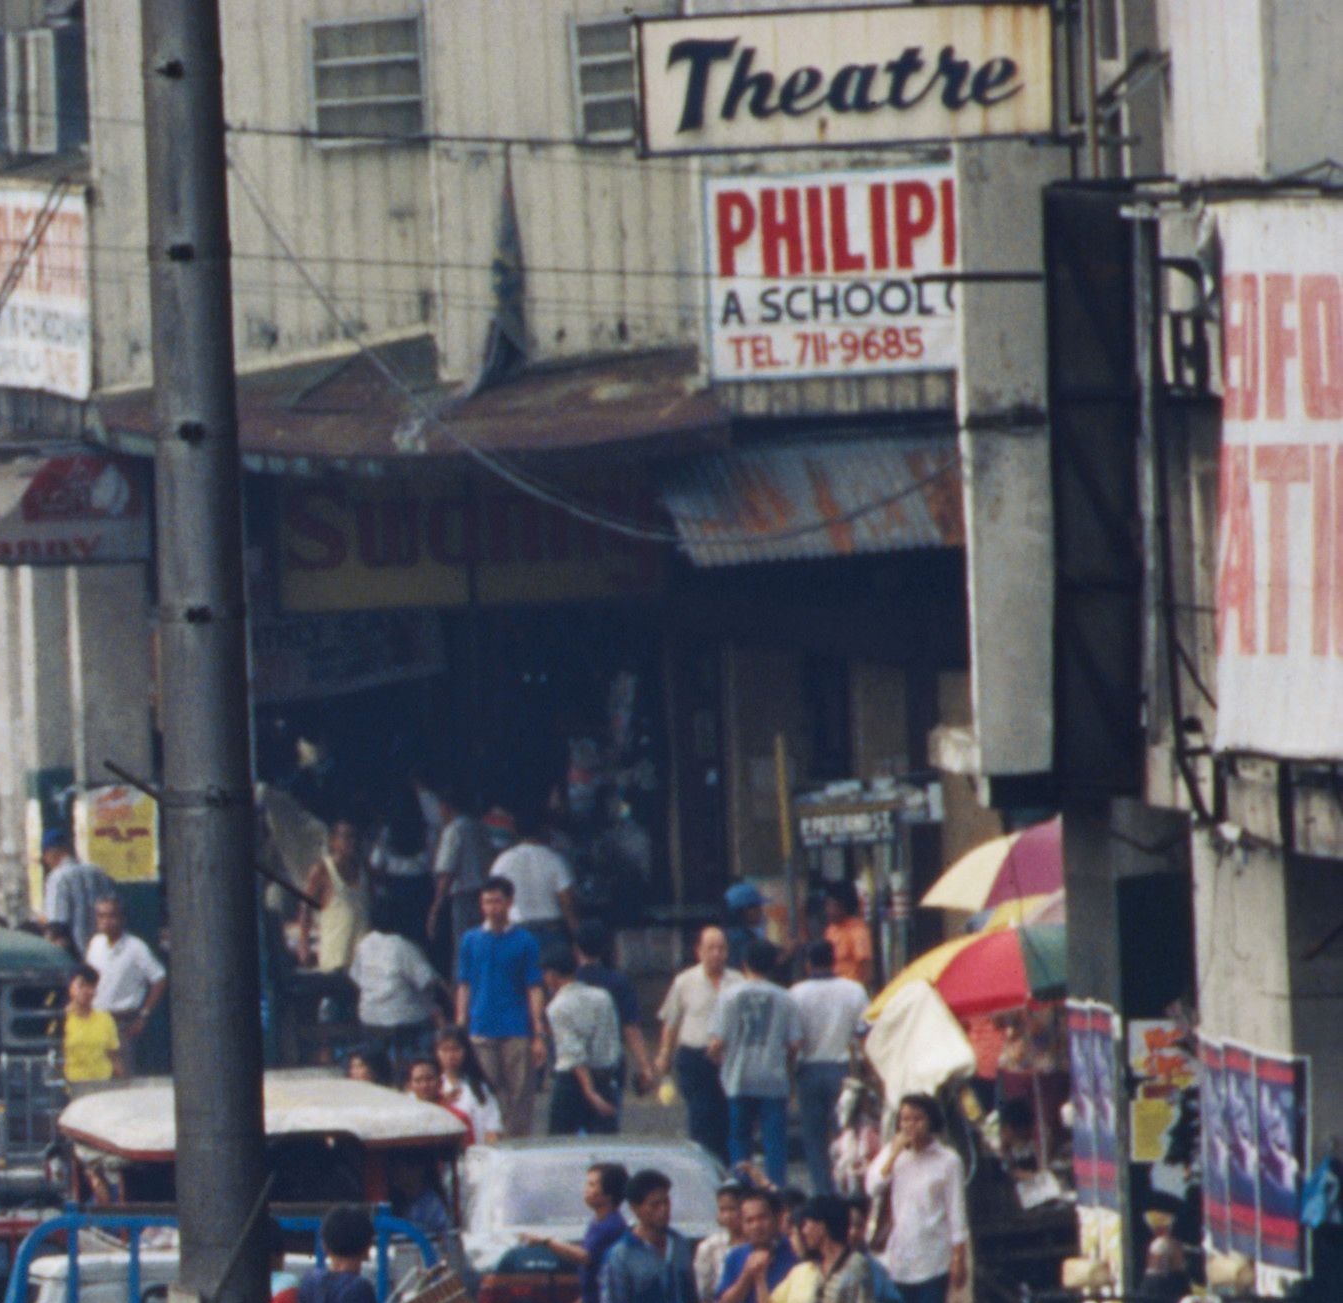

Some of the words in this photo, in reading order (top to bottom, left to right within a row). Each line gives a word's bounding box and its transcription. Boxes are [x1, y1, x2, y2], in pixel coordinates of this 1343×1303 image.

[665, 36, 1025, 134] Theatre
[721, 289, 745, 326] A
[758, 280, 935, 323] SCHOOL
[727, 335, 789, 371] TEL.
[793, 326, 925, 367] 711-9685
